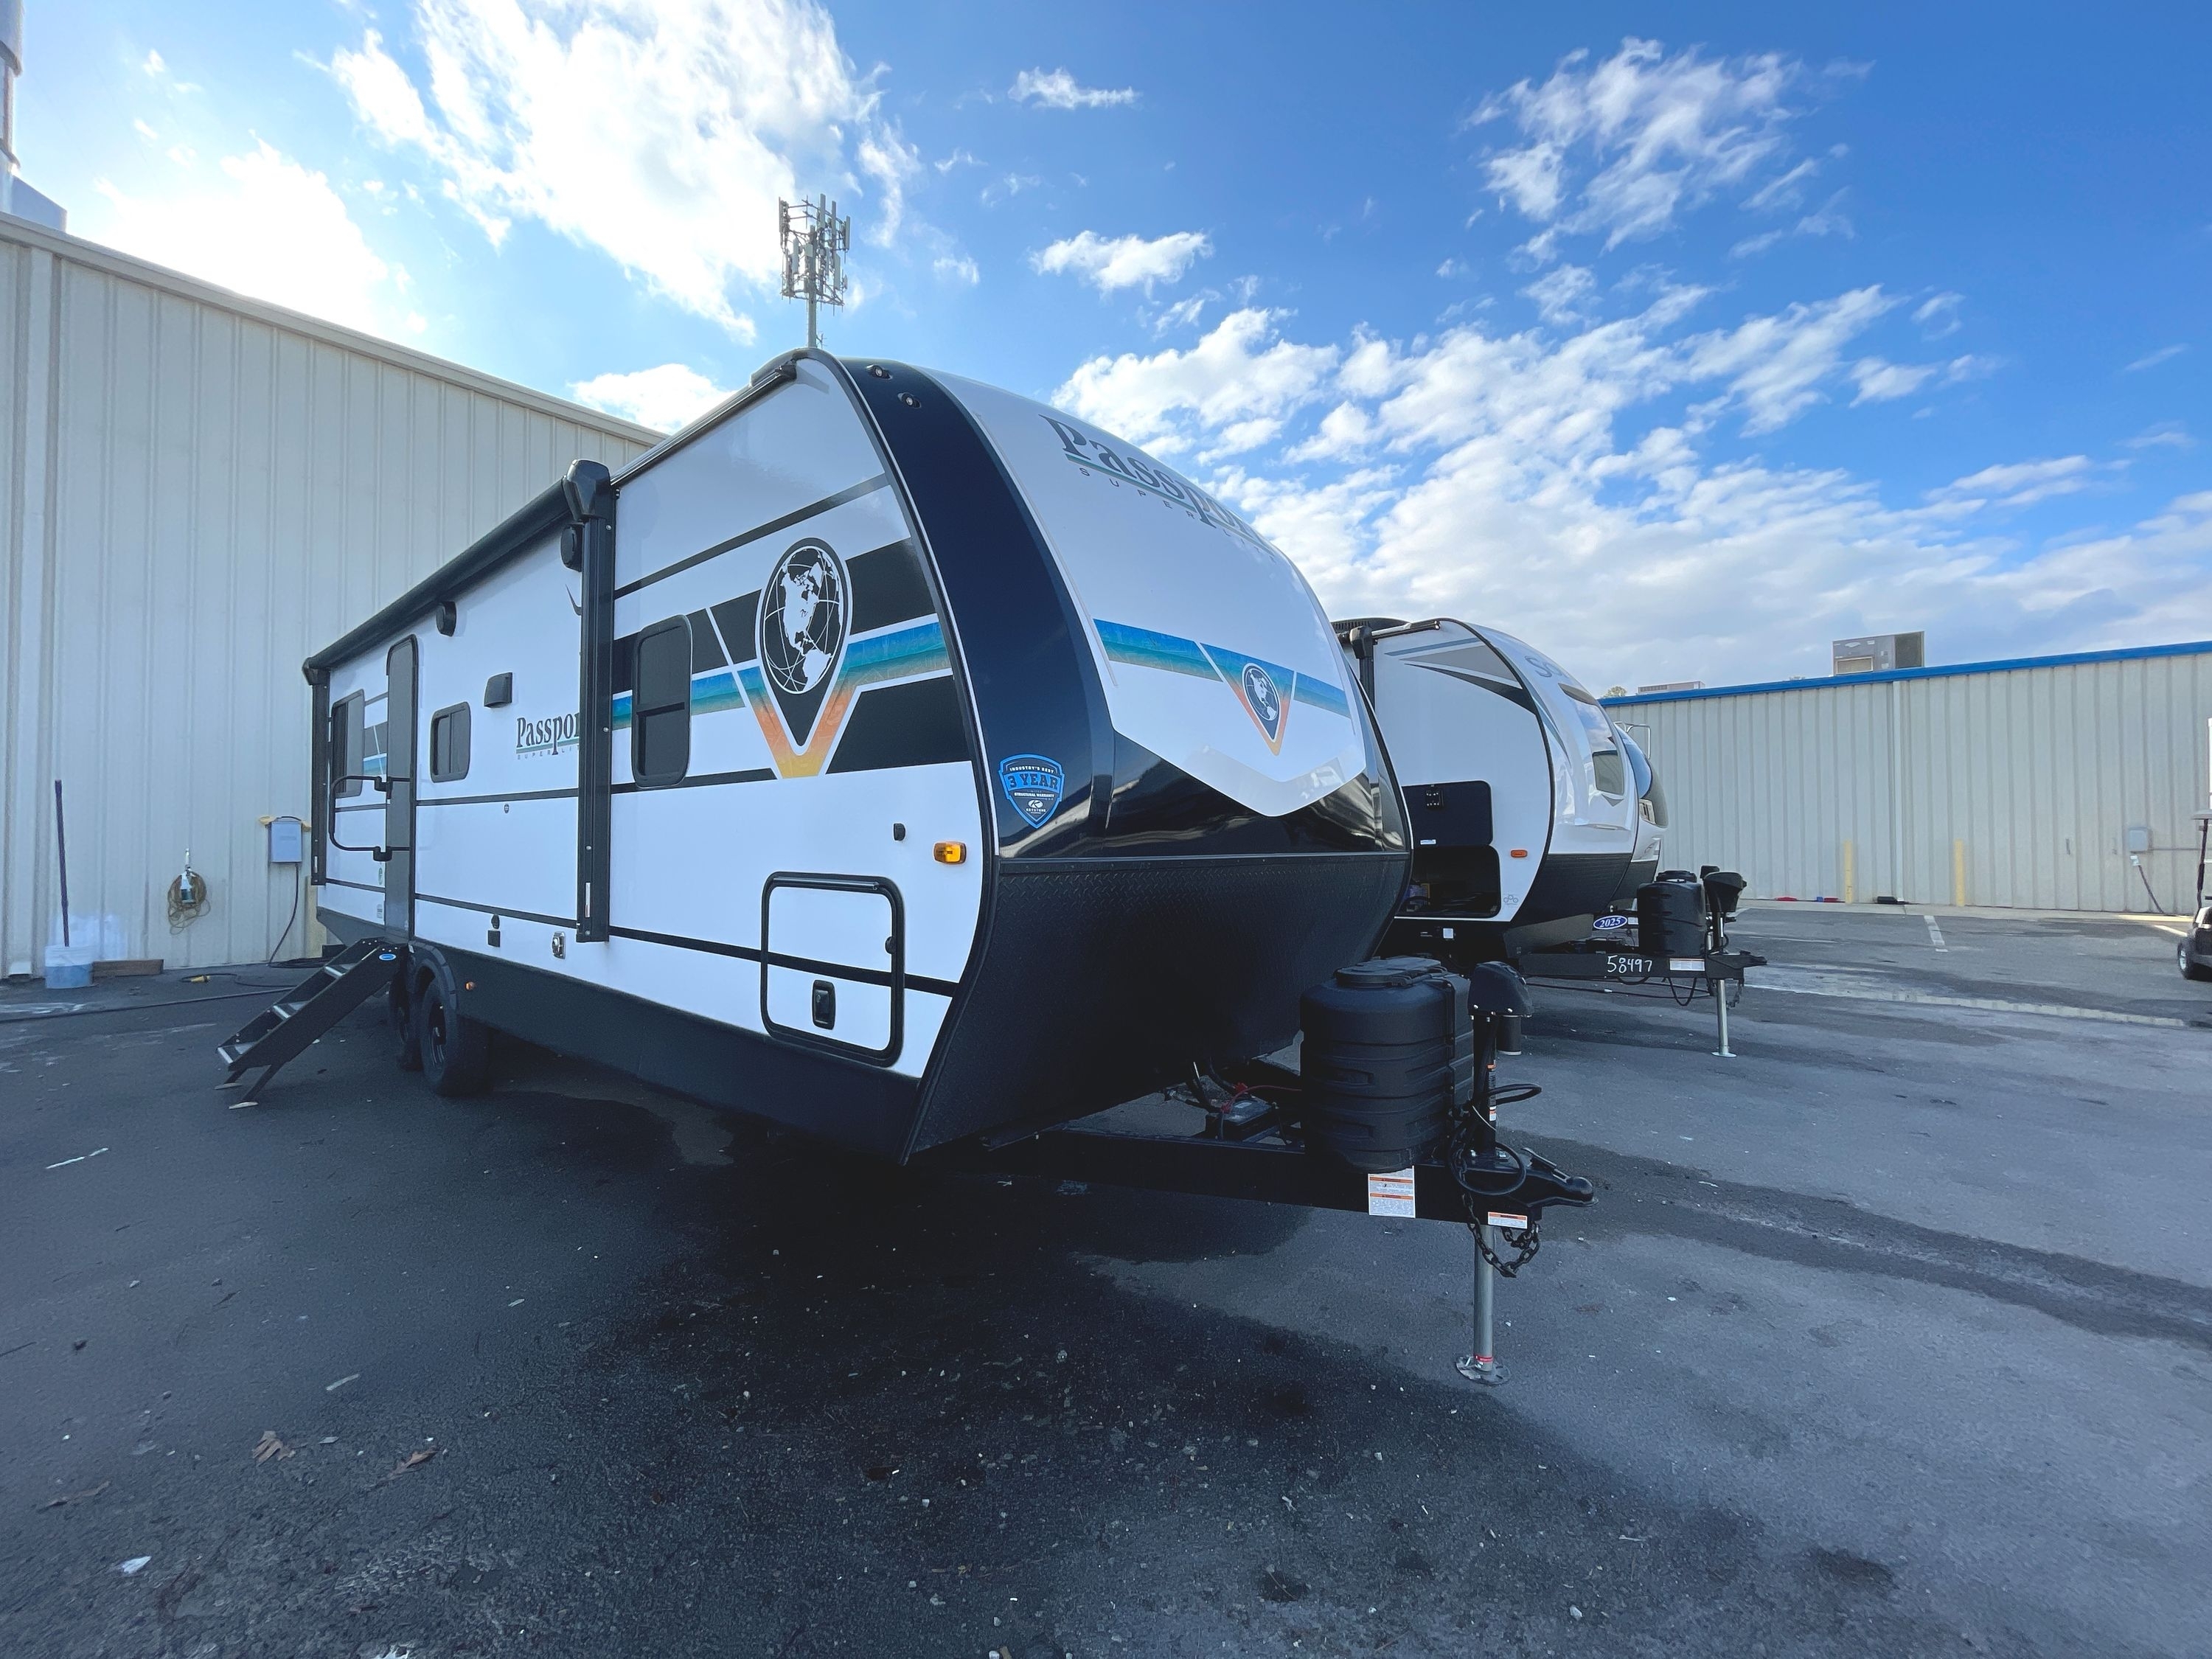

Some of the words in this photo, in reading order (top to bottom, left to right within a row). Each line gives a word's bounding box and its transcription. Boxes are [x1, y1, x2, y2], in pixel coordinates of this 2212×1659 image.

[1079, 467, 1195, 519] SUPER
[516, 712, 580, 756] Passpor
[517, 750, 551, 760] SUPER
[1007, 775, 1017, 788] 3
[1019, 773, 1058, 790] YEAR
[1599, 917, 1622, 928] 2025
[1607, 954, 1652, 973] 58497
